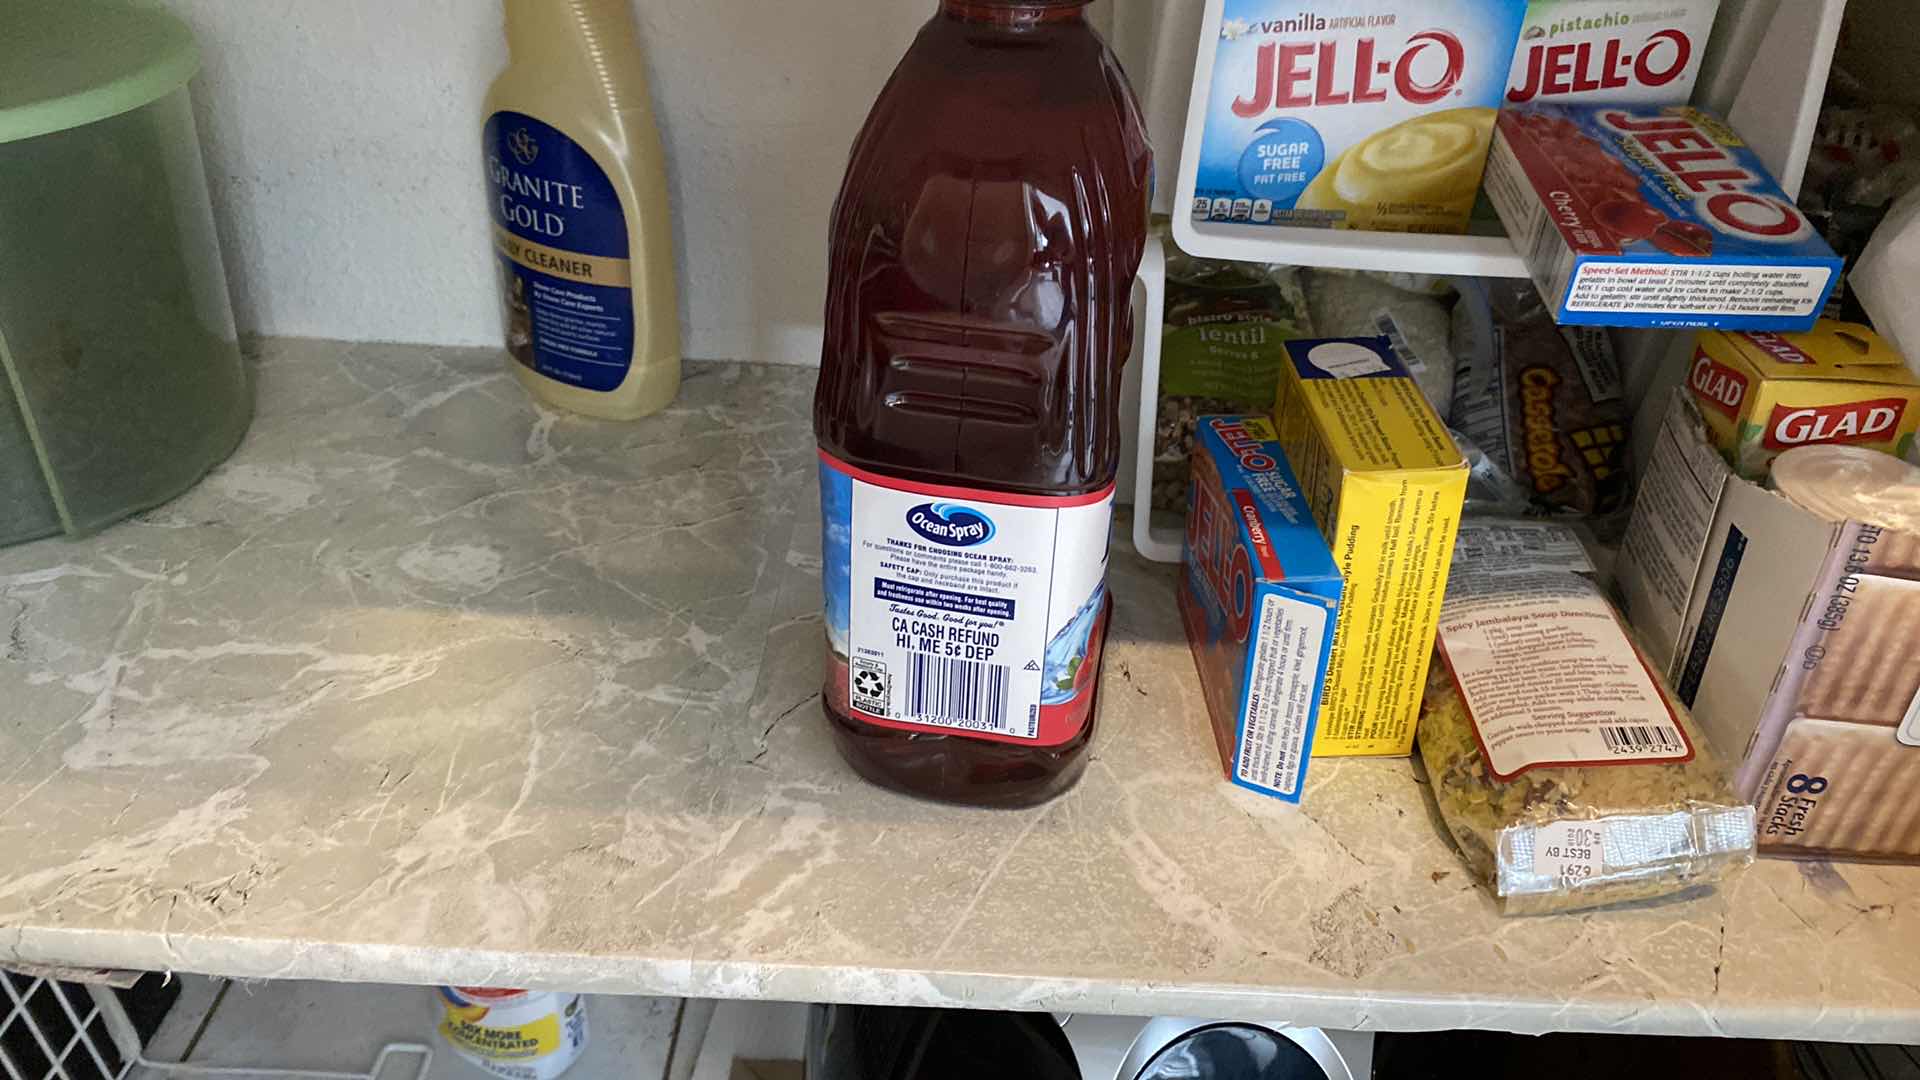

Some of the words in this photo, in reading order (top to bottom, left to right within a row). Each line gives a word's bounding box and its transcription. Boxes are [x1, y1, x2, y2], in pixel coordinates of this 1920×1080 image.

[1261, 13, 1326, 34] vanilla
[1550, 13, 1629, 38] pistachio
[1231, 27, 1465, 118] JELL-O
[1507, 29, 1691, 103] JELL-O
[1257, 142, 1309, 157] SUGAR
[1263, 155, 1300, 170] FREE
[1604, 111, 1801, 236] JELL-O
[489, 155, 584, 209] GRANITE
[1254, 173, 1277, 185] FAT
[1278, 171, 1306, 184] FREE
[500, 194, 564, 237] GOLD
[1549, 190, 1579, 228] Cherry
[524, 248, 593, 278] CLEANER
[1581, 266, 1629, 276] Speed-Set
[1630, 267, 1669, 276] Method:
[1670, 269, 1688, 277] STIR
[1732, 271, 1761, 279] boiling
[1199, 327, 1266, 346] lentil
[1692, 356, 1745, 407] GLAD
[1774, 406, 1897, 445] GLAD
[1254, 472, 1274, 493] FREE
[1266, 470, 1297, 499] SUGAR
[911, 511, 948, 537] Ocean
[949, 520, 984, 542] Spray
[1242, 504, 1267, 546] Cranberry
[862, 540, 873, 548] For
[948, 558, 969, 566] please
[970, 559, 982, 567] call
[887, 538, 912, 549] THANKS
[914, 543, 927, 552] FOR
[929, 547, 962, 558] CHOOSING
[964, 552, 987, 561] OCEAN
[880, 561, 904, 571] SAFETY
[924, 570, 938, 578] Only
[940, 574, 970, 584] purchase
[985, 579, 1012, 588] product
[890, 554, 910, 562] Please
[912, 558, 926, 566] have
[939, 562, 957, 571] entire
[959, 565, 985, 576] package
[881, 581, 895, 590] Must
[939, 594, 962, 603] opening.
[988, 600, 1008, 610] quality
[1836, 575, 1859, 595] OZ
[877, 589, 888, 597] and
[925, 598, 943, 607] within
[987, 607, 1012, 617] opening.
[1320, 677, 1332, 705] BIRD'S
[1345, 524, 1359, 560] Pudding
[1817, 592, 1850, 632] (385g)
[889, 603, 915, 616] Tastes
[943, 613, 965, 624] Good
[965, 618, 978, 629] for
[1445, 620, 1474, 635] Spicy
[1475, 612, 1530, 629] Jambalaya
[1531, 610, 1558, 622] Soup
[1559, 609, 1611, 623] Directions
[892, 616, 908, 634] CA
[911, 620, 945, 640] CASH
[948, 627, 1000, 648] REFUND
[919, 637, 941, 655] ME
[945, 641, 962, 657] 5¢
[965, 645, 995, 661] DEP
[855, 694, 882, 707] PLASTIC
[856, 702, 881, 714] BOTTLE
[958, 720, 994, 731] 20031
[1532, 710, 1567, 722] Serving
[1568, 709, 1617, 720] Suggestion
[1245, 729, 1254, 739] OR
[1242, 739, 1252, 755] FRUIT
[1277, 750, 1286, 760] not
[1613, 743, 1644, 755] 2439
[1650, 743, 1683, 754] 2747
[1240, 755, 1250, 768] ADD
[1276, 760, 1284, 769] Do
[1787, 773, 1828, 795] 8
[1765, 795, 1790, 836] Stacks
[1785, 798, 1817, 837] Fresh
[1575, 828, 1592, 847] 30
[1545, 845, 1560, 857] BY
[1562, 847, 1591, 859] BEST
[1559, 863, 1591, 876] 6291
[484, 1027, 522, 1039] MORE
